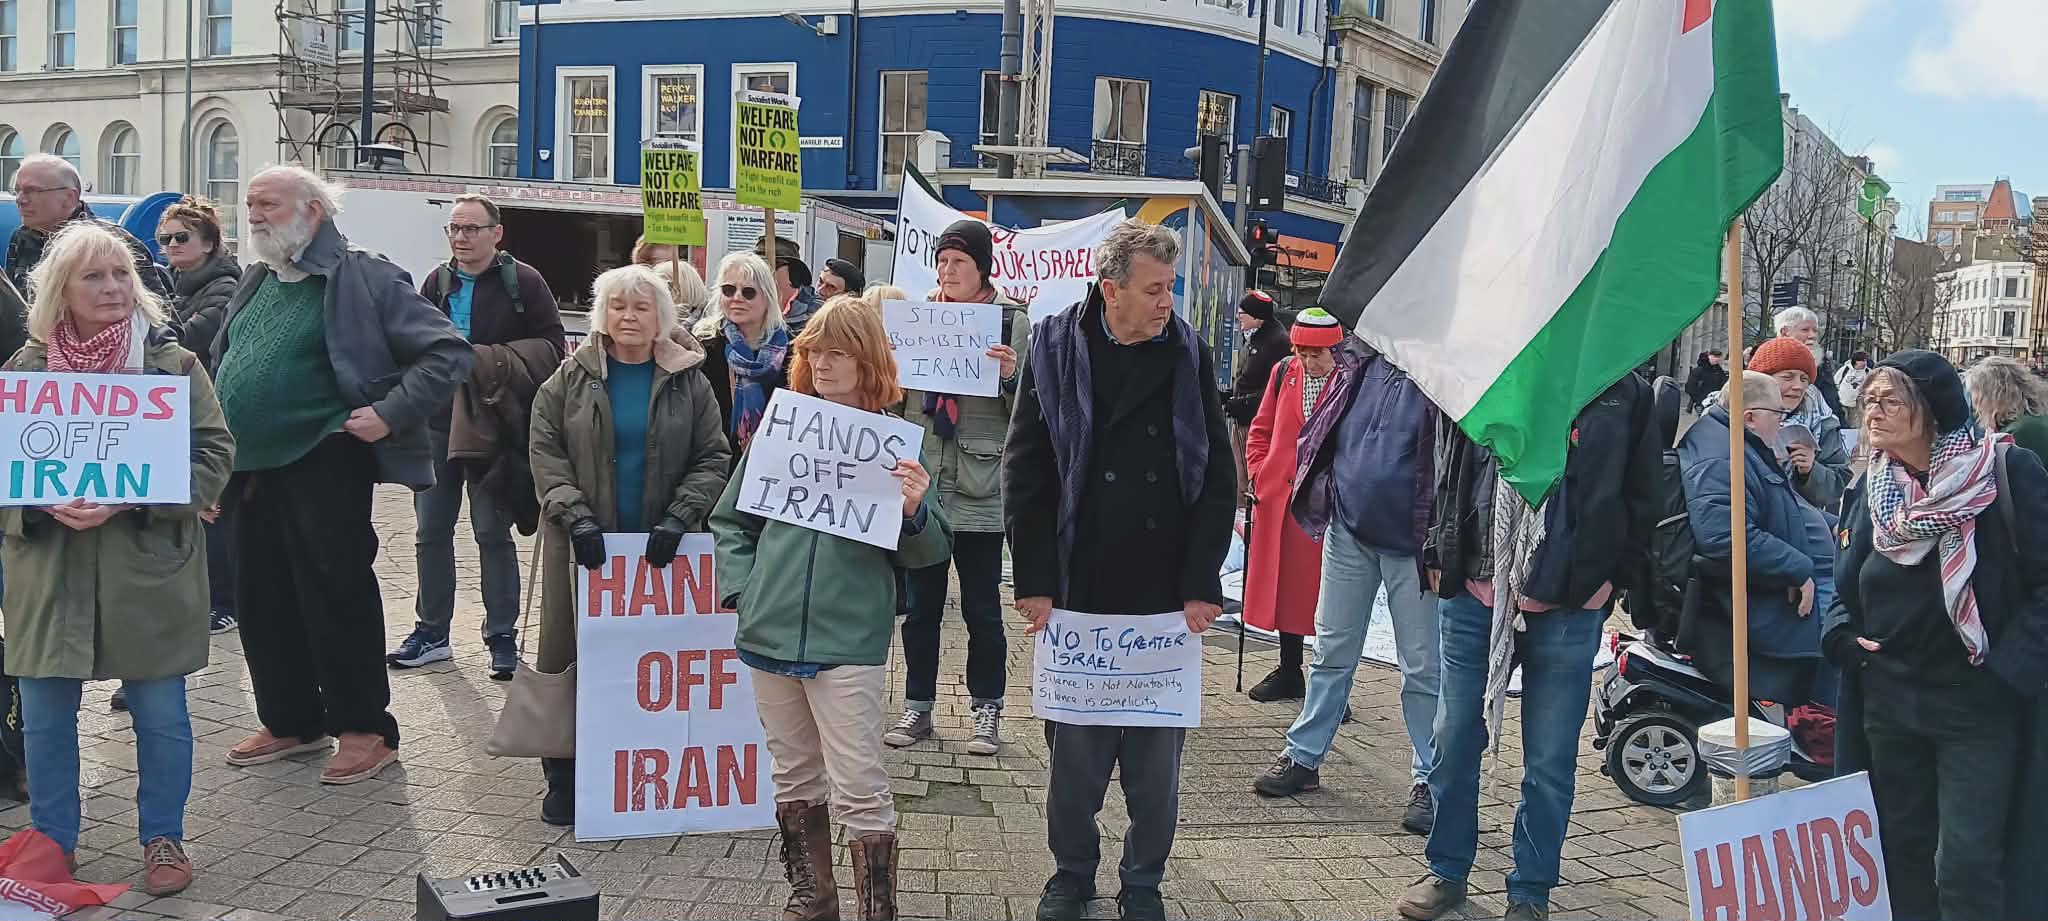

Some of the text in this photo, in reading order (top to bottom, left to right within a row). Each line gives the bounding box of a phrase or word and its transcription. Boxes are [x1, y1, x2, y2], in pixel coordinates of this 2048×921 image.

[660, 84, 691, 93] PERCY
[661, 95, 696, 103] WALKER
[740, 106, 795, 131] WELFARE
[740, 126, 766, 148] NOT
[645, 152, 693, 172] WELFARE
[740, 147, 798, 173] WARFARE
[646, 172, 669, 190] NOT
[646, 191, 700, 210] WARFARE
[901, 217, 918, 255] TO
[905, 307, 975, 326] STOP
[890, 332, 1000, 349] BOMBING
[912, 357, 980, 380] IRAN
[0, 379, 177, 420] HANDS
[20, 420, 129, 460] OFF
[765, 403, 906, 471] HANDS
[9, 459, 150, 498] IRAN
[789, 453, 857, 489] OFF
[750, 476, 878, 534] IRAN
[1042, 623, 1081, 650] NO
[1052, 650, 1122, 671] ISRAEL
[637, 648, 737, 713] OFF
[1039, 673, 1082, 689] Silence
[1102, 680, 1121, 691] Not
[1039, 687, 1078, 704] Silence
[614, 744, 757, 813] IRAN
[1694, 809, 1880, 921] HANDS
